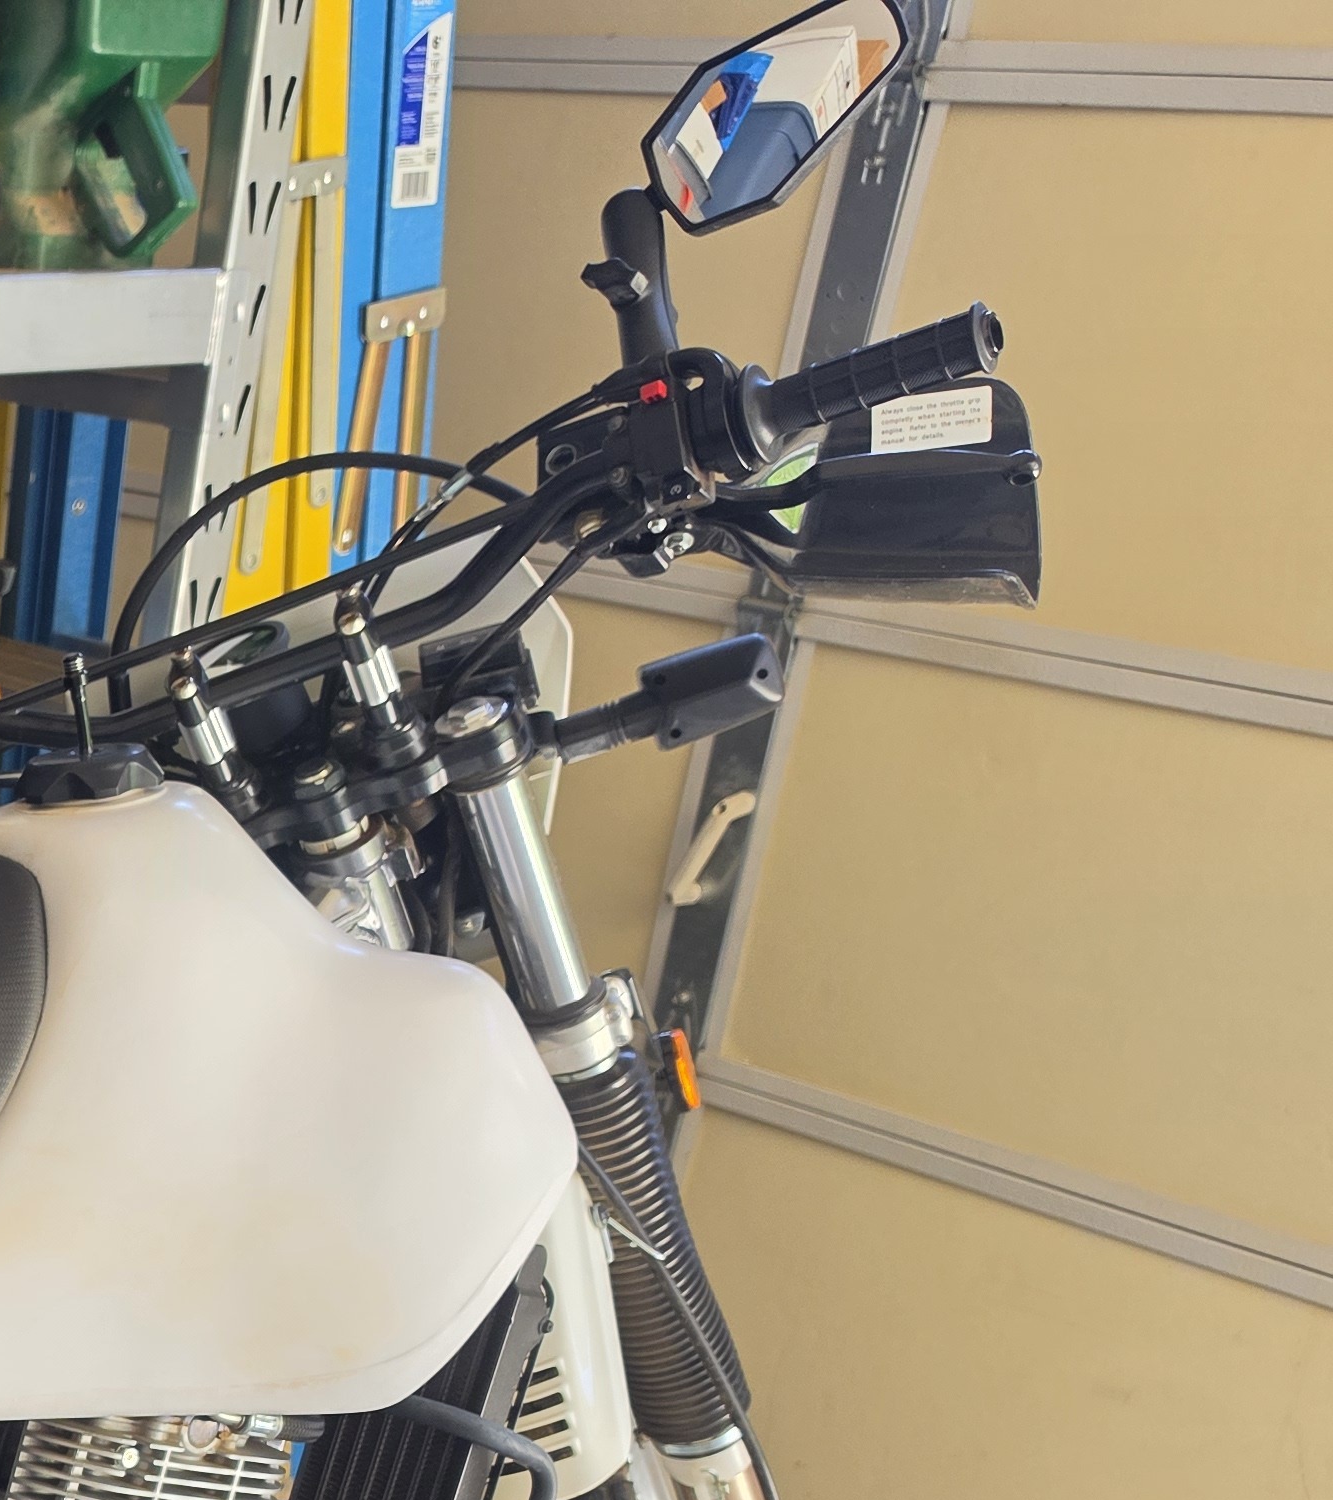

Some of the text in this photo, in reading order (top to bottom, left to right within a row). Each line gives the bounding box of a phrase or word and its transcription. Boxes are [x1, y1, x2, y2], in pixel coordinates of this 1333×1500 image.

[880, 407, 904, 416] Always
[906, 404, 924, 412] close
[940, 399, 964, 408] throttle
[968, 397, 981, 405] grip
[917, 412, 935, 420] when
[939, 409, 966, 418] starting
[880, 437, 905, 446] manual
[908, 434, 918, 442] for
